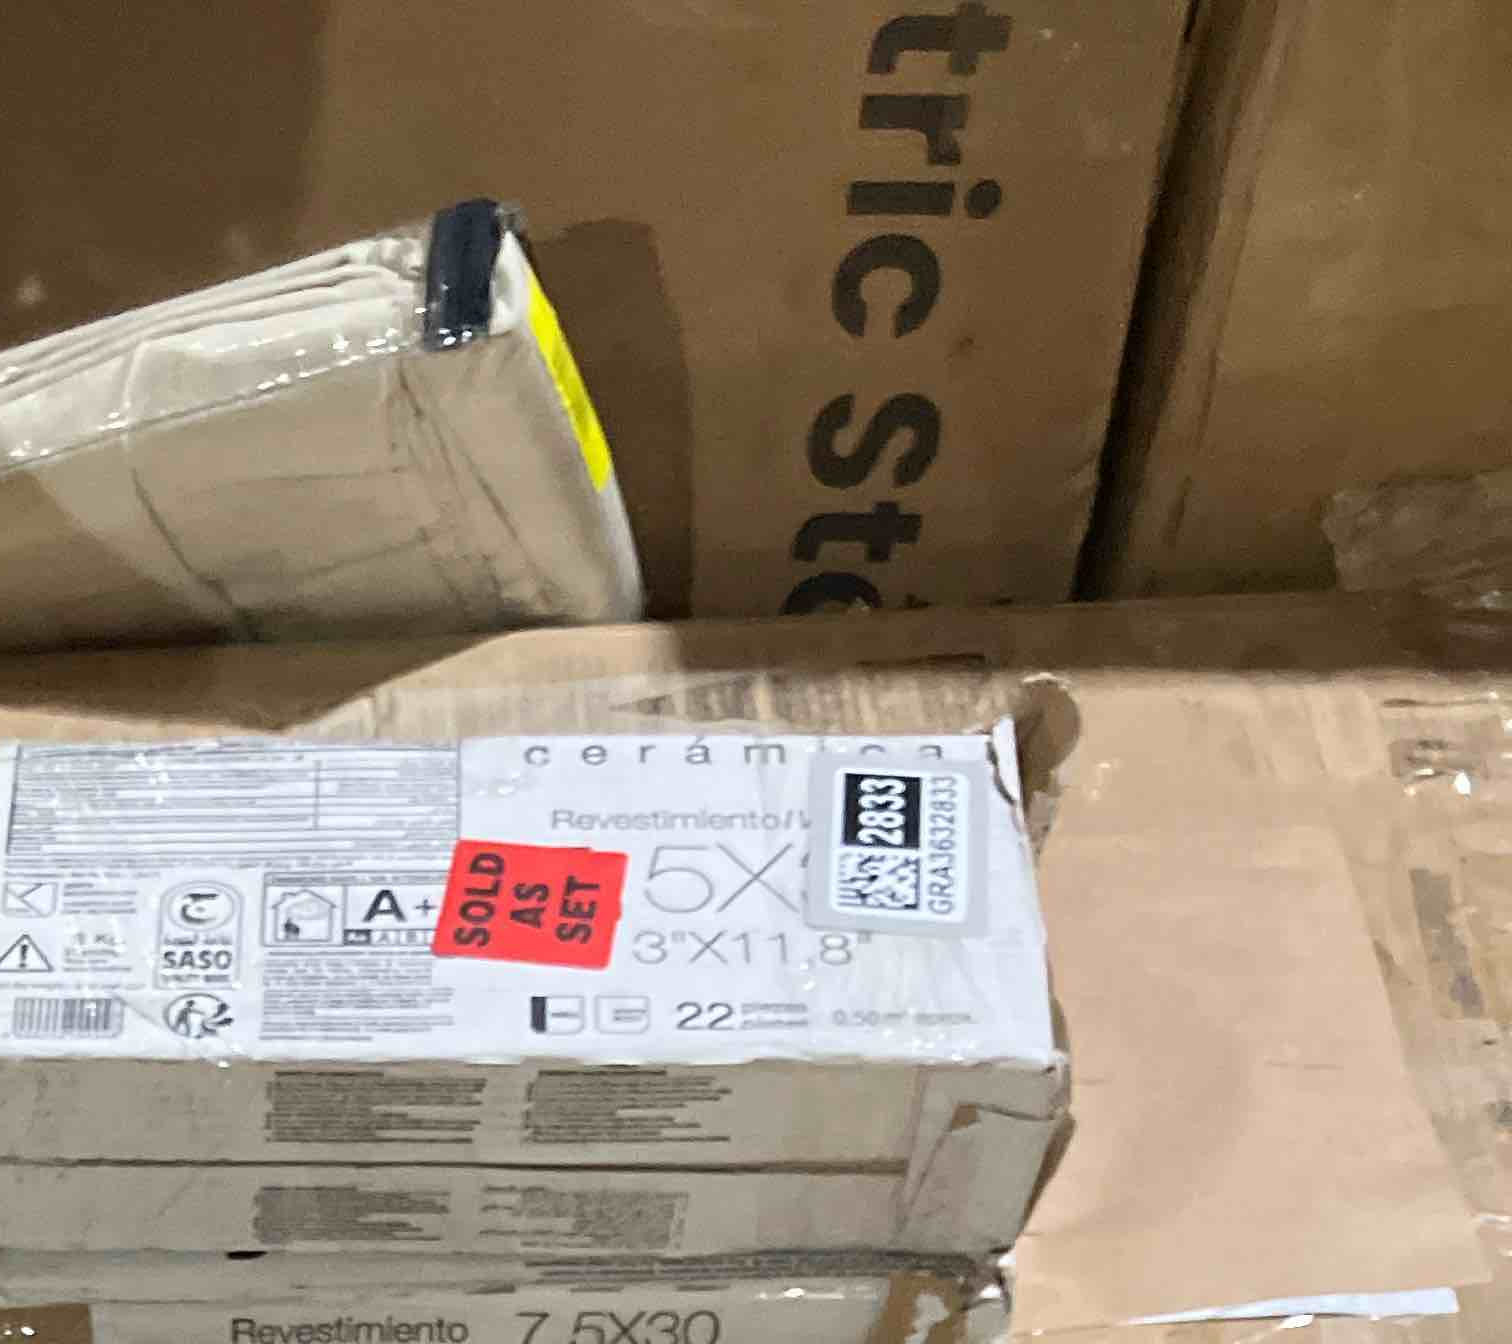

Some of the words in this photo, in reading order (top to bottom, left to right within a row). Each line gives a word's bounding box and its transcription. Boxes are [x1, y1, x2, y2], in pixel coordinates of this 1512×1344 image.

[856, 777, 906, 848] 2833
[927, 776, 958, 916] GRA3632833
[454, 851, 505, 949] SOLD
[509, 881, 550, 930] AS
[555, 875, 600, 944] SET
[644, 842, 814, 914] 5X
[163, 950, 233, 970] SASO
[675, 1001, 735, 1031] 22
